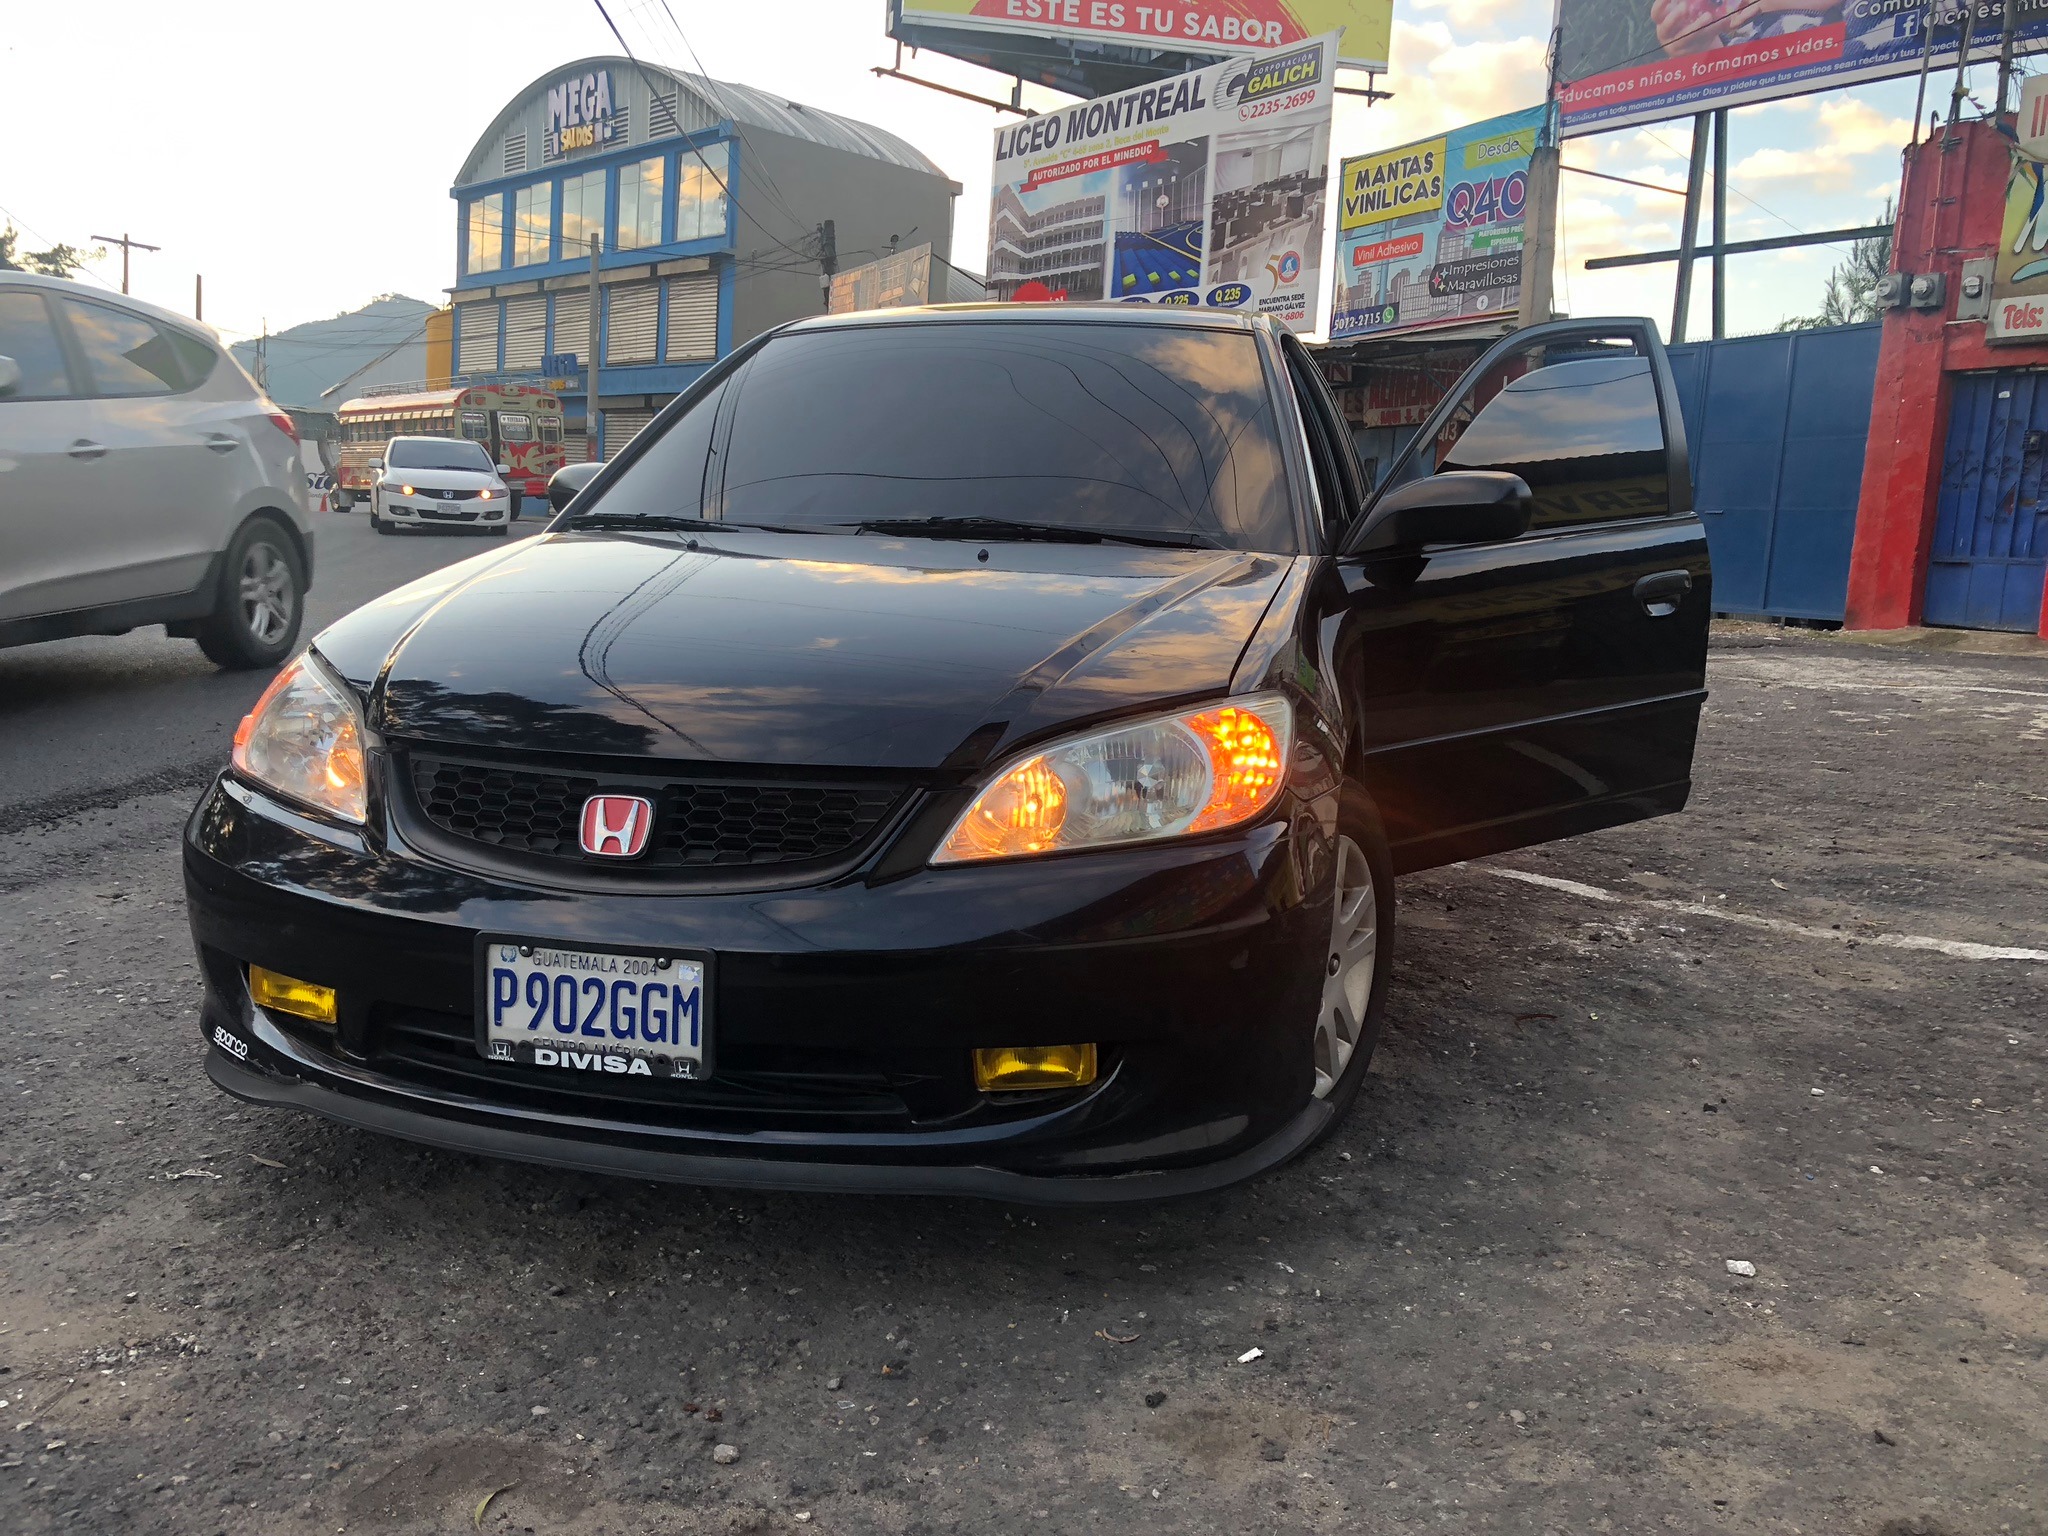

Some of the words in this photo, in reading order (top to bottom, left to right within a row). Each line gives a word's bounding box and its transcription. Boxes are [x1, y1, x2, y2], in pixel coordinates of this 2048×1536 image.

[1006, 0, 1080, 23] ESTE
[1090, 1, 1125, 28] ES
[1135, 6, 1174, 33] TU
[1183, 12, 1283, 45] SABOR
[1247, 60, 1316, 94] GALICH
[1253, 52, 1313, 76] CORPORACIÓN
[1639, 69, 1687, 88] niños,
[1691, 47, 1779, 77] formamos
[1785, 36, 1839, 57] vidas.
[1609, 105, 1627, 115] todo
[1628, 97, 1665, 112] momento
[1666, 93, 1675, 104] al
[1676, 91, 1701, 102] Señor
[1702, 86, 1722, 97] Dios
[1758, 75, 1776, 86] que
[1777, 73, 1792, 82] tus
[1793, 64, 1832, 78] caminos
[1833, 60, 1857, 70] sean
[1858, 52, 1890, 65] rectos
[1900, 48, 1915, 58] tus
[547, 70, 612, 133] MEGA
[1249, 89, 1316, 119] 2235-2699
[995, 115, 1062, 162] LICEO
[1065, 74, 1206, 144] MONTREAL
[1032, 164, 1081, 182] AUTORIZADO
[1082, 157, 1099, 170] POR
[1101, 155, 1112, 166] EL
[1113, 144, 1153, 163] MINEDUC
[1477, 136, 1520, 161] Desde
[1354, 151, 1434, 192] MANTAS
[1345, 175, 1441, 217] VINÍLICAS
[1446, 169, 1528, 227] Q40
[1356, 246, 1375, 262] Vinil
[1376, 239, 1419, 259] Adhesivo
[1448, 255, 1520, 278] Impresiones
[1215, 289, 1223, 303] Q
[1224, 286, 1242, 301] 235
[1446, 272, 1519, 293] Maravillosas
[1258, 294, 1290, 306] ENCUENTRA
[1291, 292, 1305, 301] SEDE
[1258, 304, 1283, 313] MARIANO
[1284, 301, 1306, 310] GÁLVEZ
[1333, 311, 1381, 331] 5072-2715
[2003, 302, 2045, 330] Tels:
[532, 949, 618, 973] GUATEMALA
[623, 959, 658, 977] 2004
[214, 1025, 249, 1057] sparco
[534, 1047, 653, 1077] DIVISA
